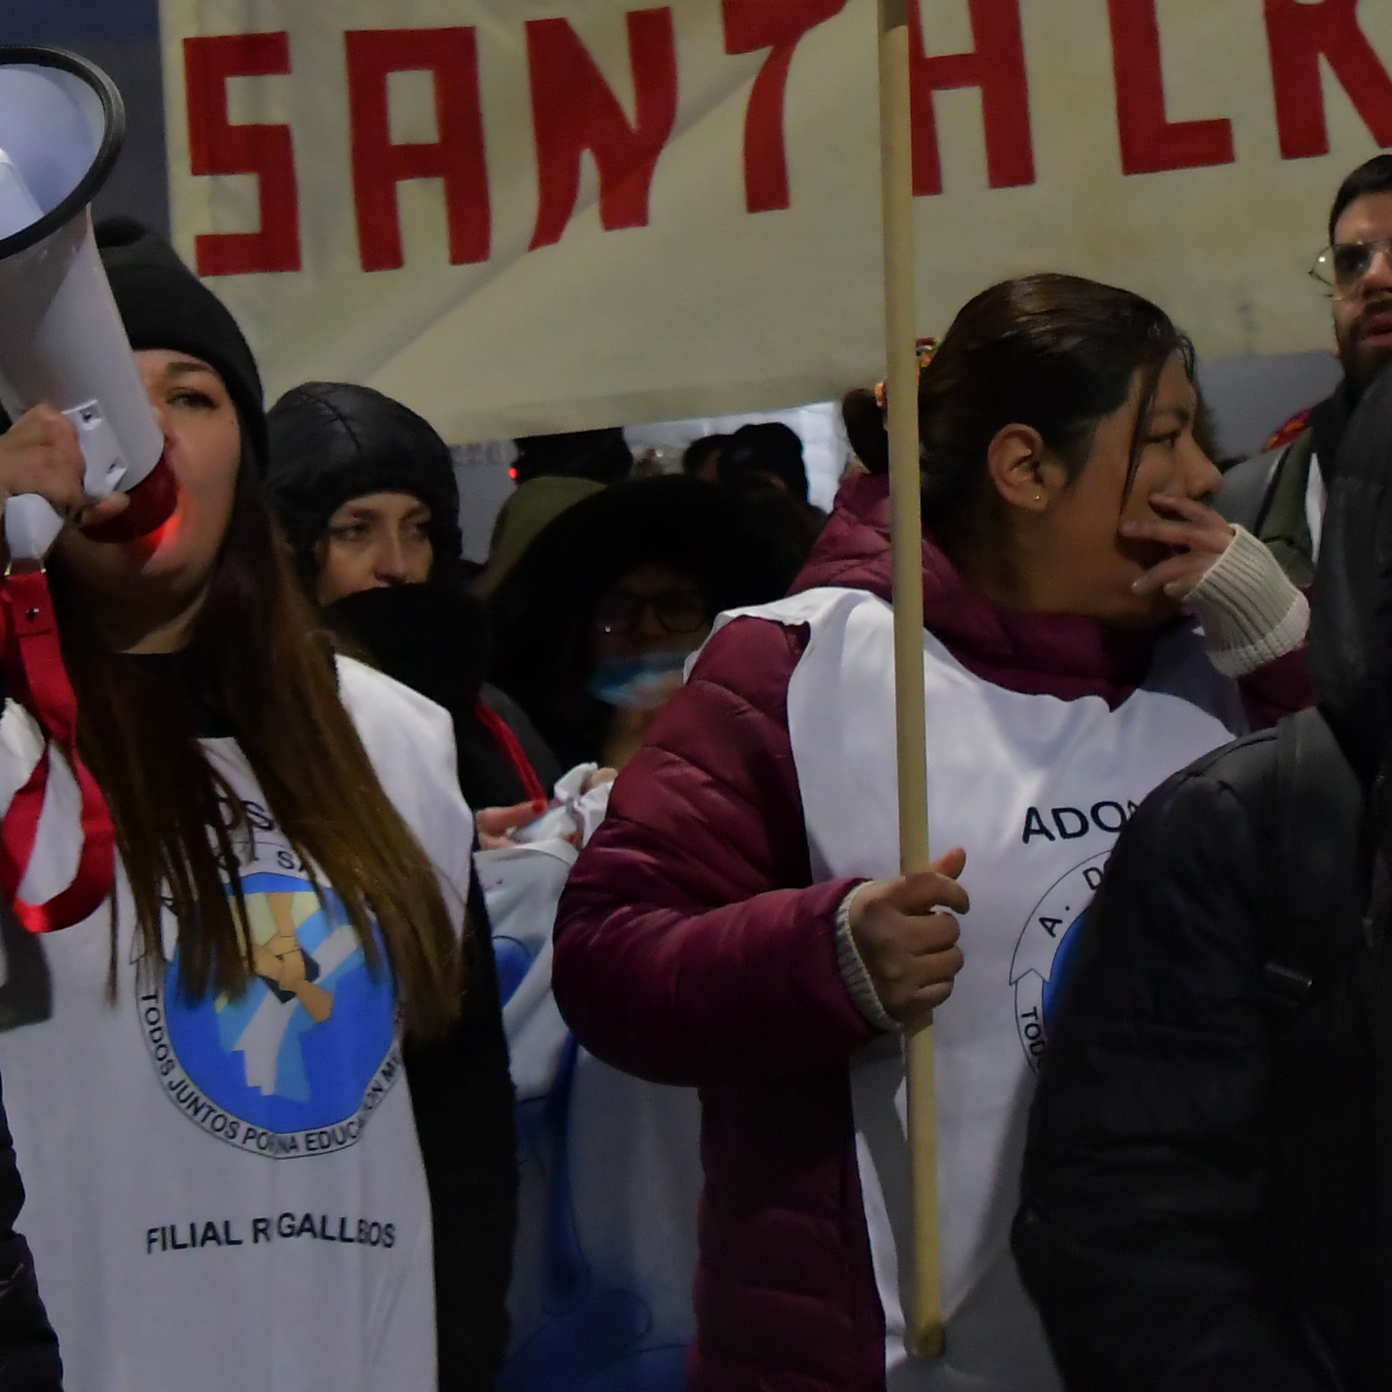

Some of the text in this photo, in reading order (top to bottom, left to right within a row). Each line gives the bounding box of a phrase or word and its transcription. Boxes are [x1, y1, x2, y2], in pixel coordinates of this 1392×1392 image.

[141, 989, 176, 1077] TODOS
[167, 1078, 241, 1140] JUNTOS
[146, 1219, 244, 1255] FILIAL
